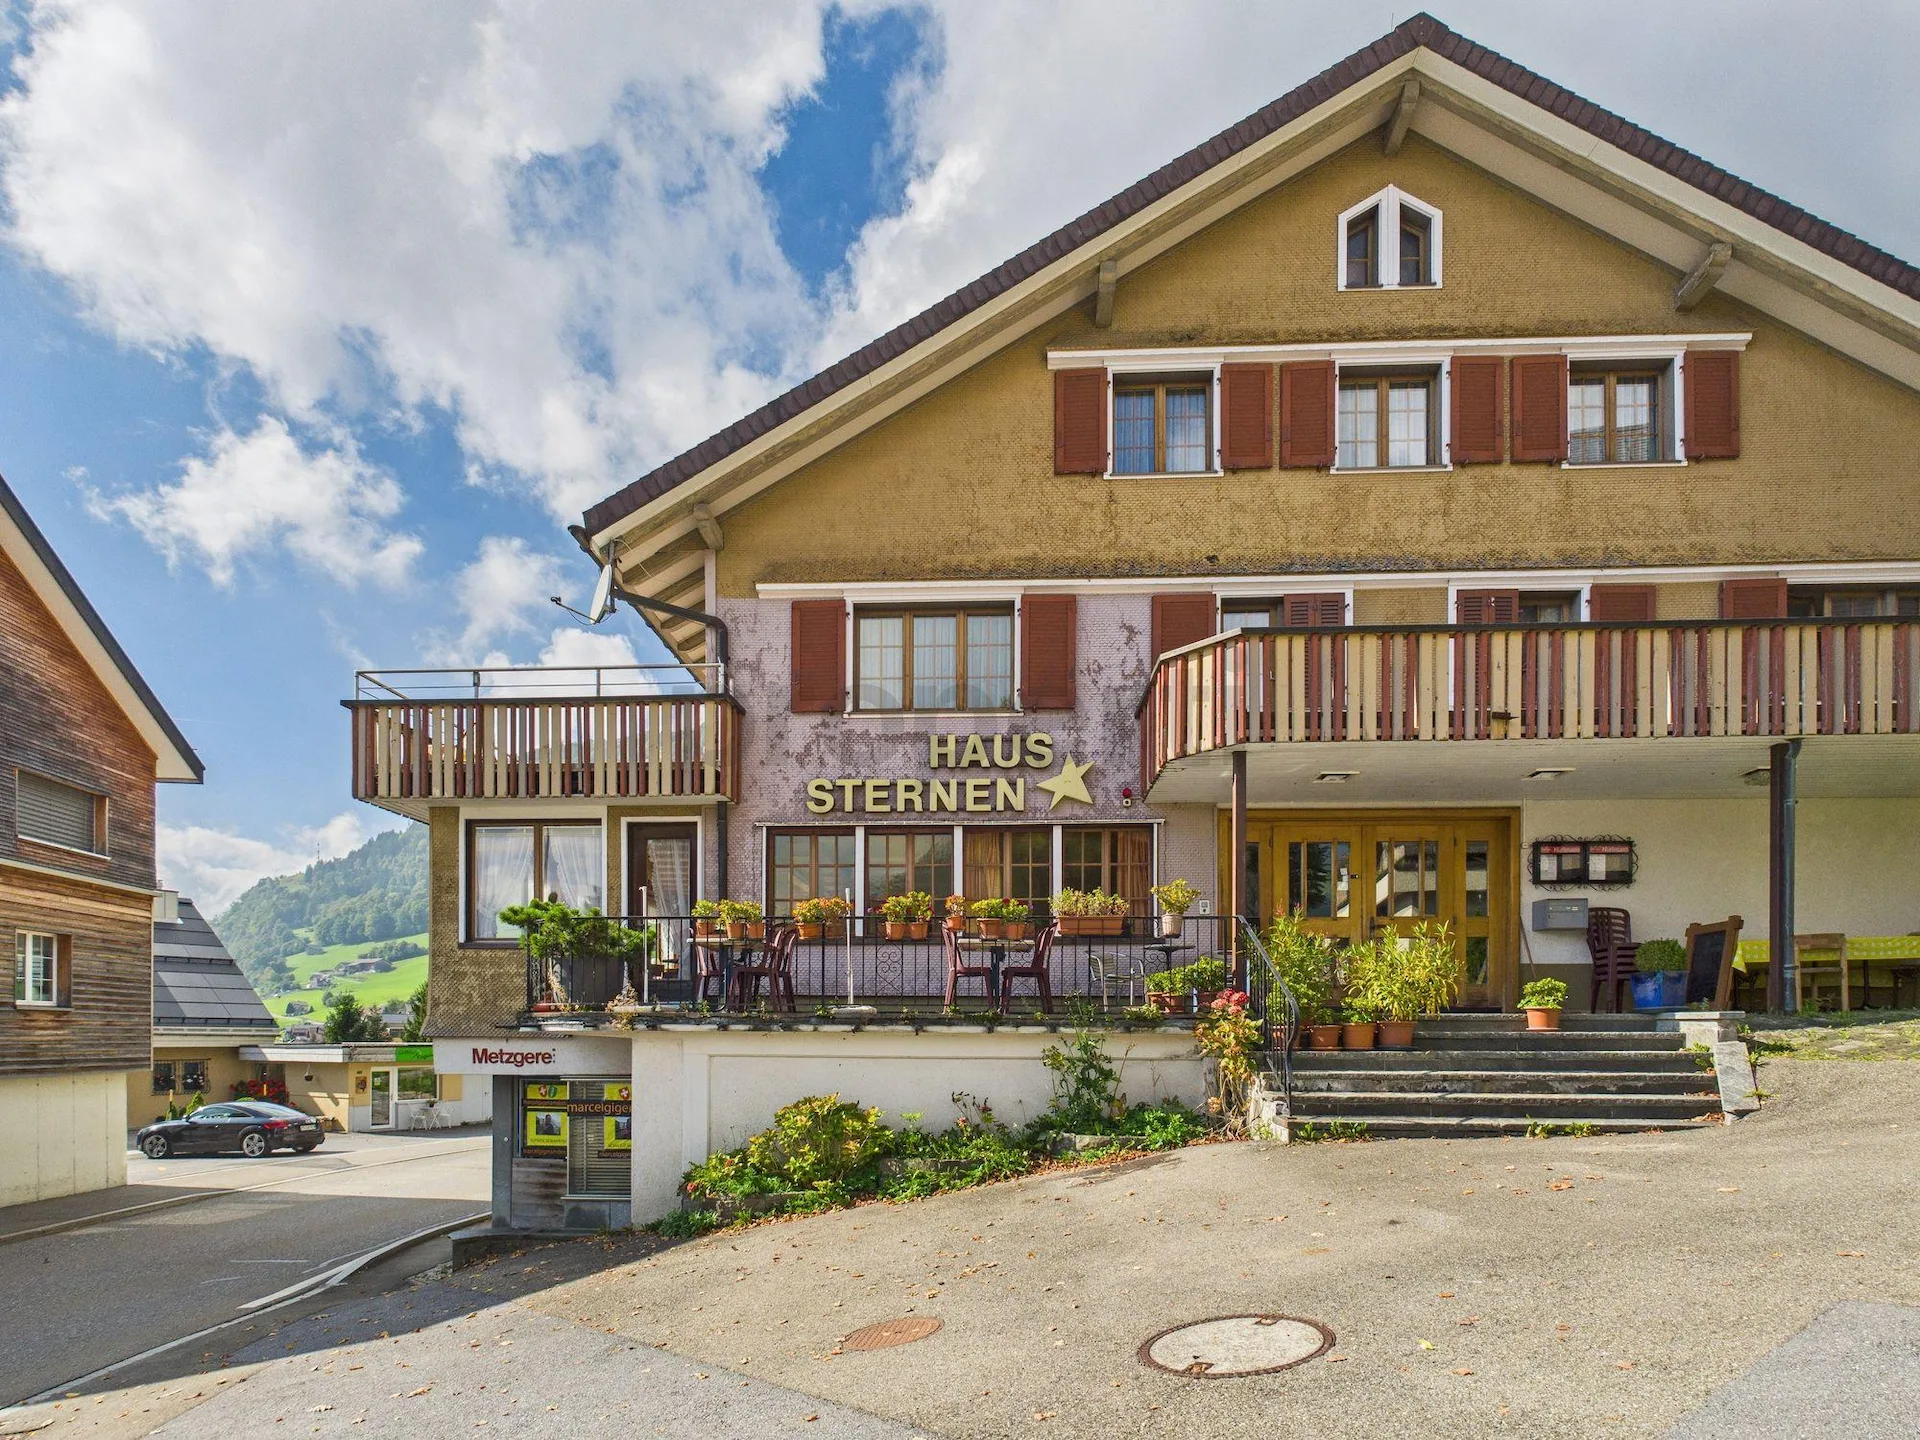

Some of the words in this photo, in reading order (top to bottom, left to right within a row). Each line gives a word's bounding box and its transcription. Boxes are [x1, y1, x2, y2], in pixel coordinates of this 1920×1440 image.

[929, 732, 1054, 769] HAUS
[806, 777, 1025, 814] STERNEN
[472, 1047, 556, 1067] Metzgere
